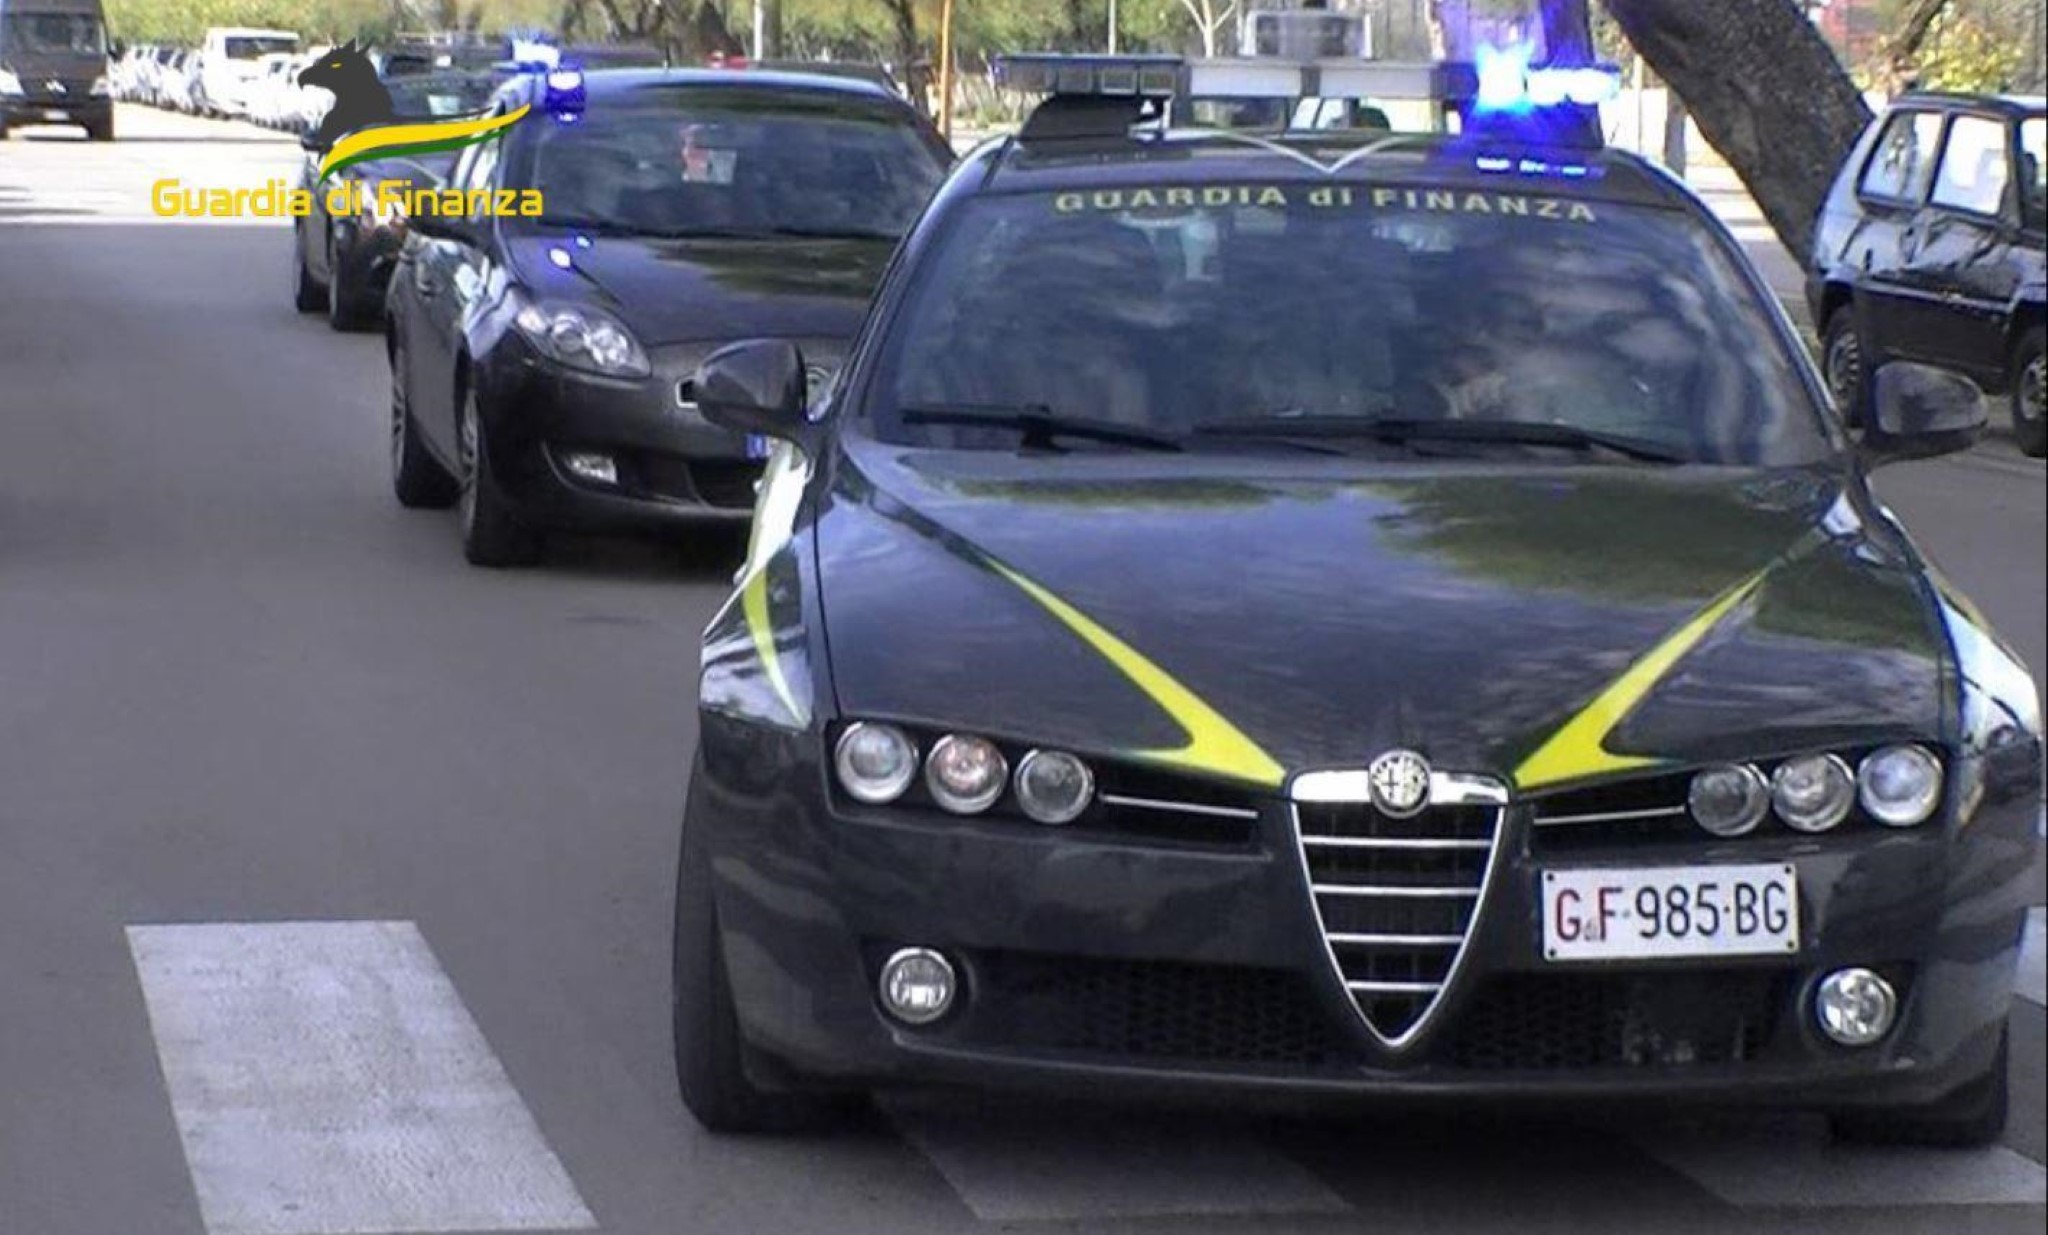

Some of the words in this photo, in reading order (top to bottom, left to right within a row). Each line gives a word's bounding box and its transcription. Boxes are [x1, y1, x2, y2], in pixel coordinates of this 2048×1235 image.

[1055, 185, 1287, 213] GUARDIA
[1309, 186, 1351, 207] di
[1375, 188, 1597, 222] FINANZA
